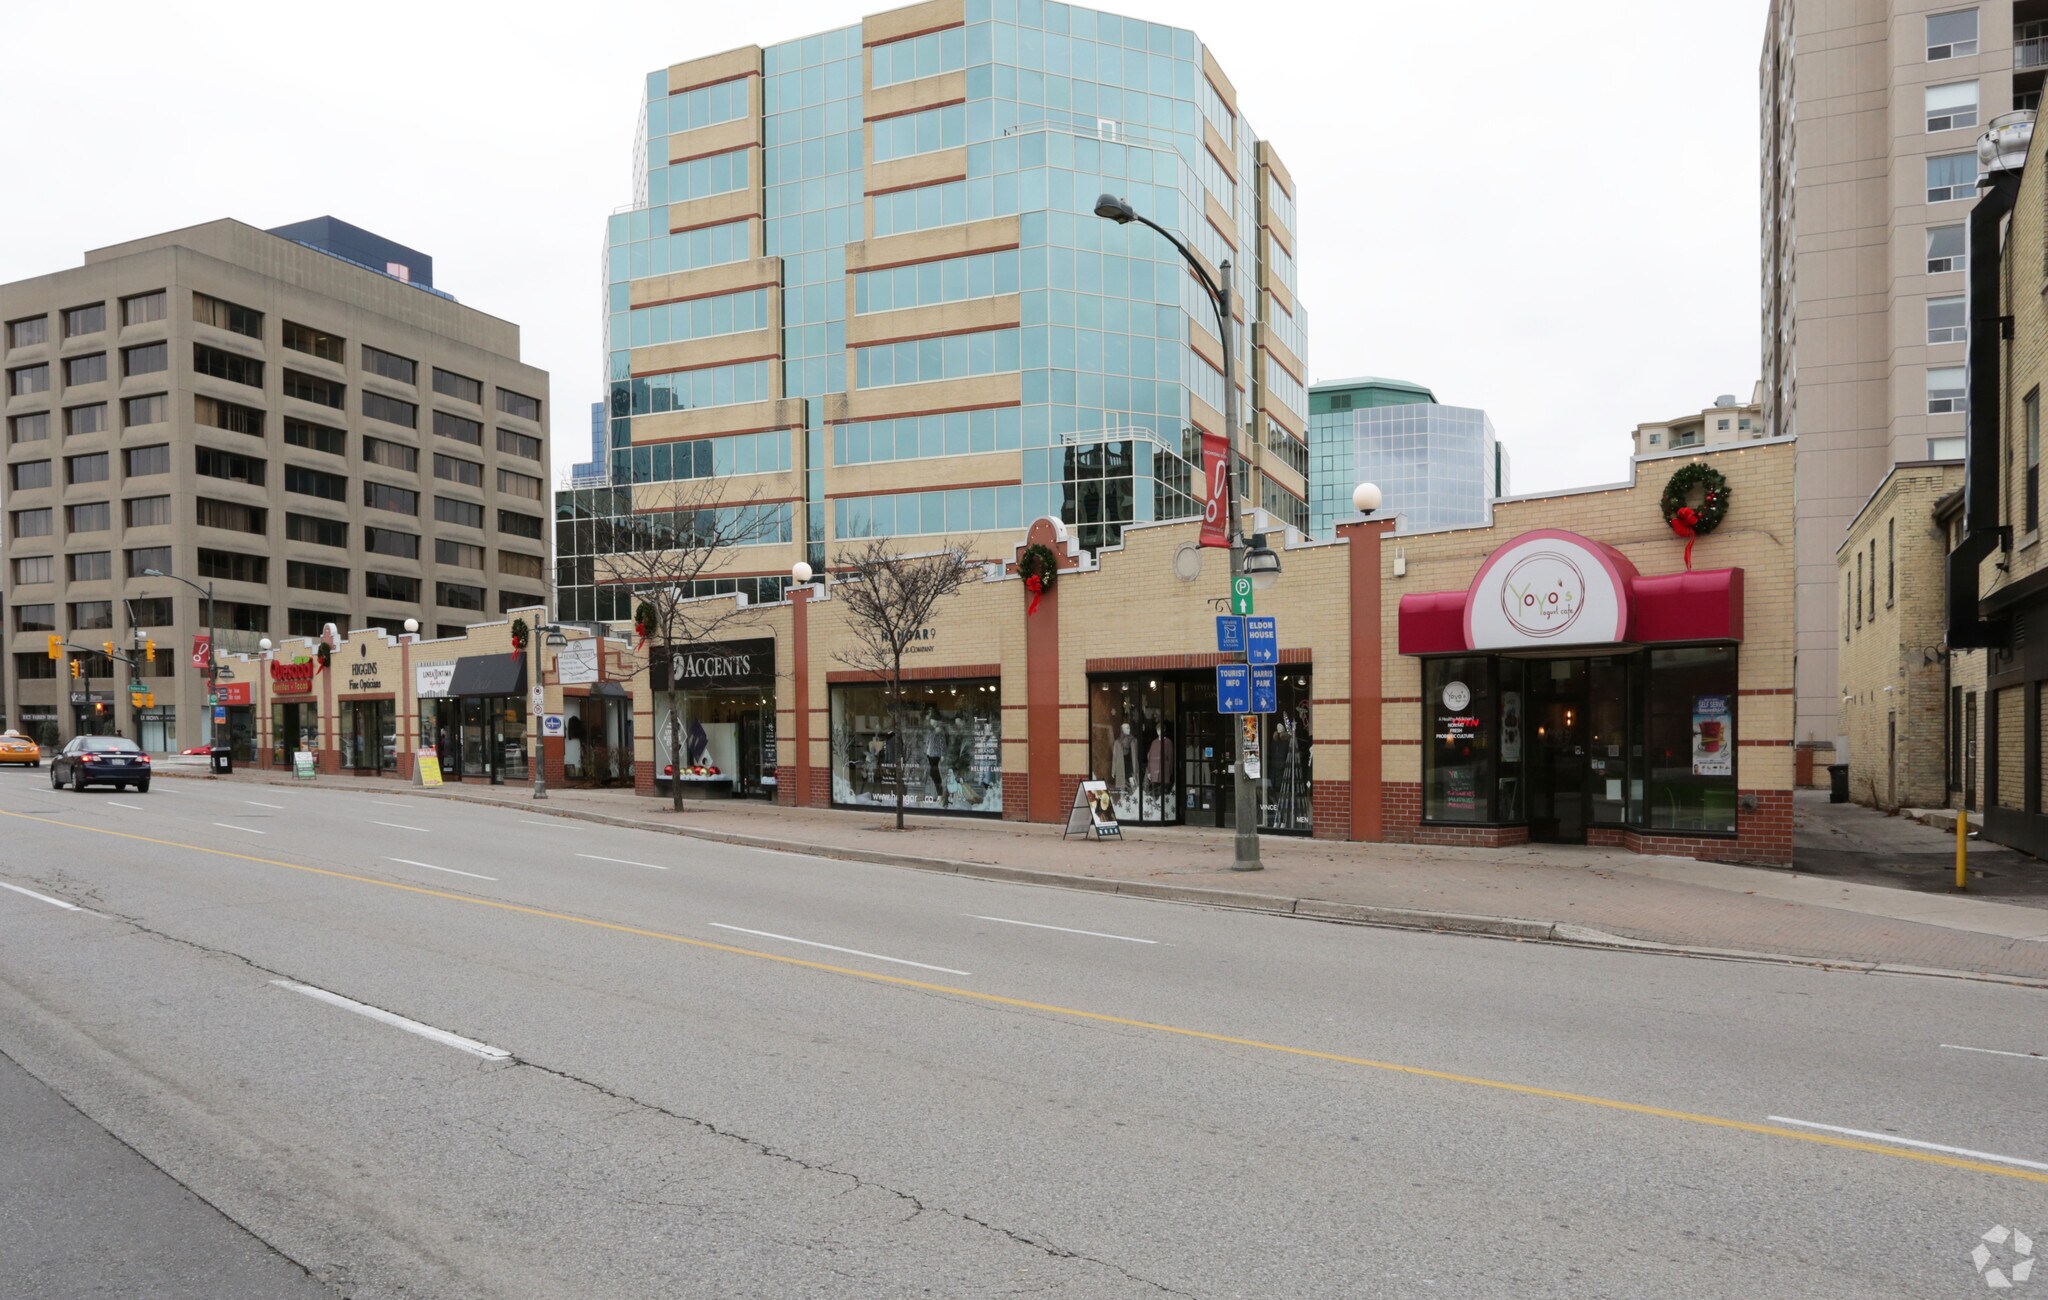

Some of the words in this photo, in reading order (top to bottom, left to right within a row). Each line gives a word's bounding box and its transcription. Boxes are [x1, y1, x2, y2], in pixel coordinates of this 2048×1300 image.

[1249, 621, 1273, 629] ELDON
[1249, 631, 1274, 639] HOUSE
[351, 662, 378, 676] HIGGINS
[684, 654, 751, 678] ACCENTS
[1220, 669, 1246, 677] TOURIST
[1253, 670, 1273, 678] HARRIS
[349, 679, 359, 690] Fine
[360, 678, 381, 692] Opticians
[1226, 679, 1240, 687] INFO
[1256, 679, 1271, 687] PARK
